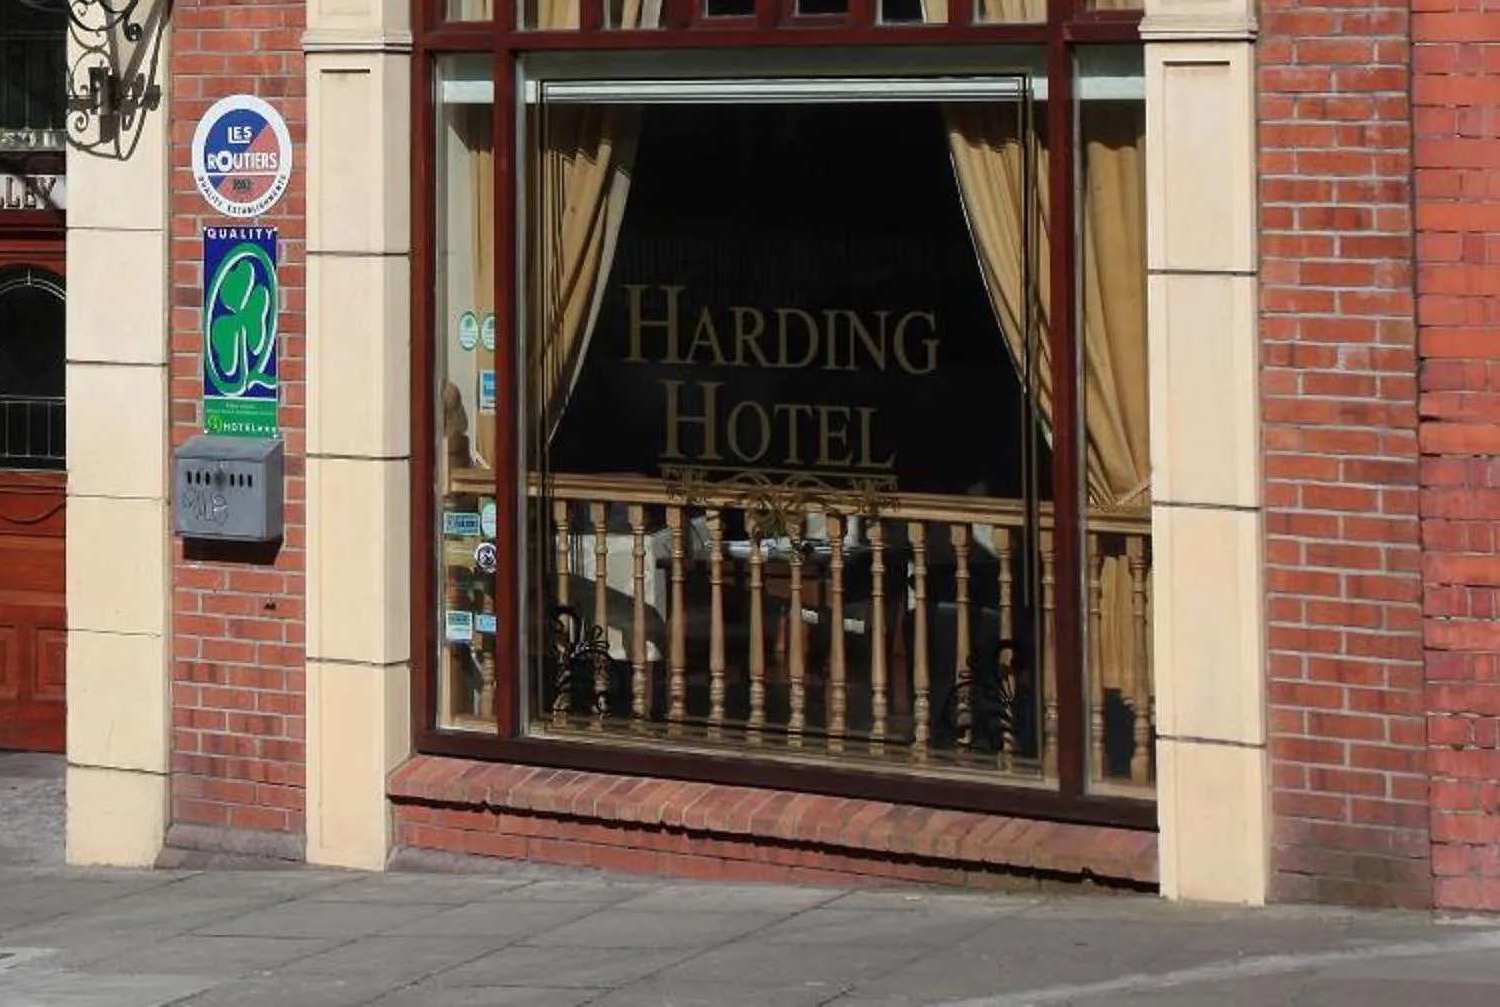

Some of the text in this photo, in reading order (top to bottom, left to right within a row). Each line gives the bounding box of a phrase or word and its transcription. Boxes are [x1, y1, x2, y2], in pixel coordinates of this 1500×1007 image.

[227, 126, 253, 144] LES
[207, 150, 277, 172] ROUTIERS
[207, 228, 274, 240] QUALITY
[623, 284, 941, 375] HARDING
[223, 421, 258, 433] HOTEL
[659, 379, 897, 469] HOTEL
